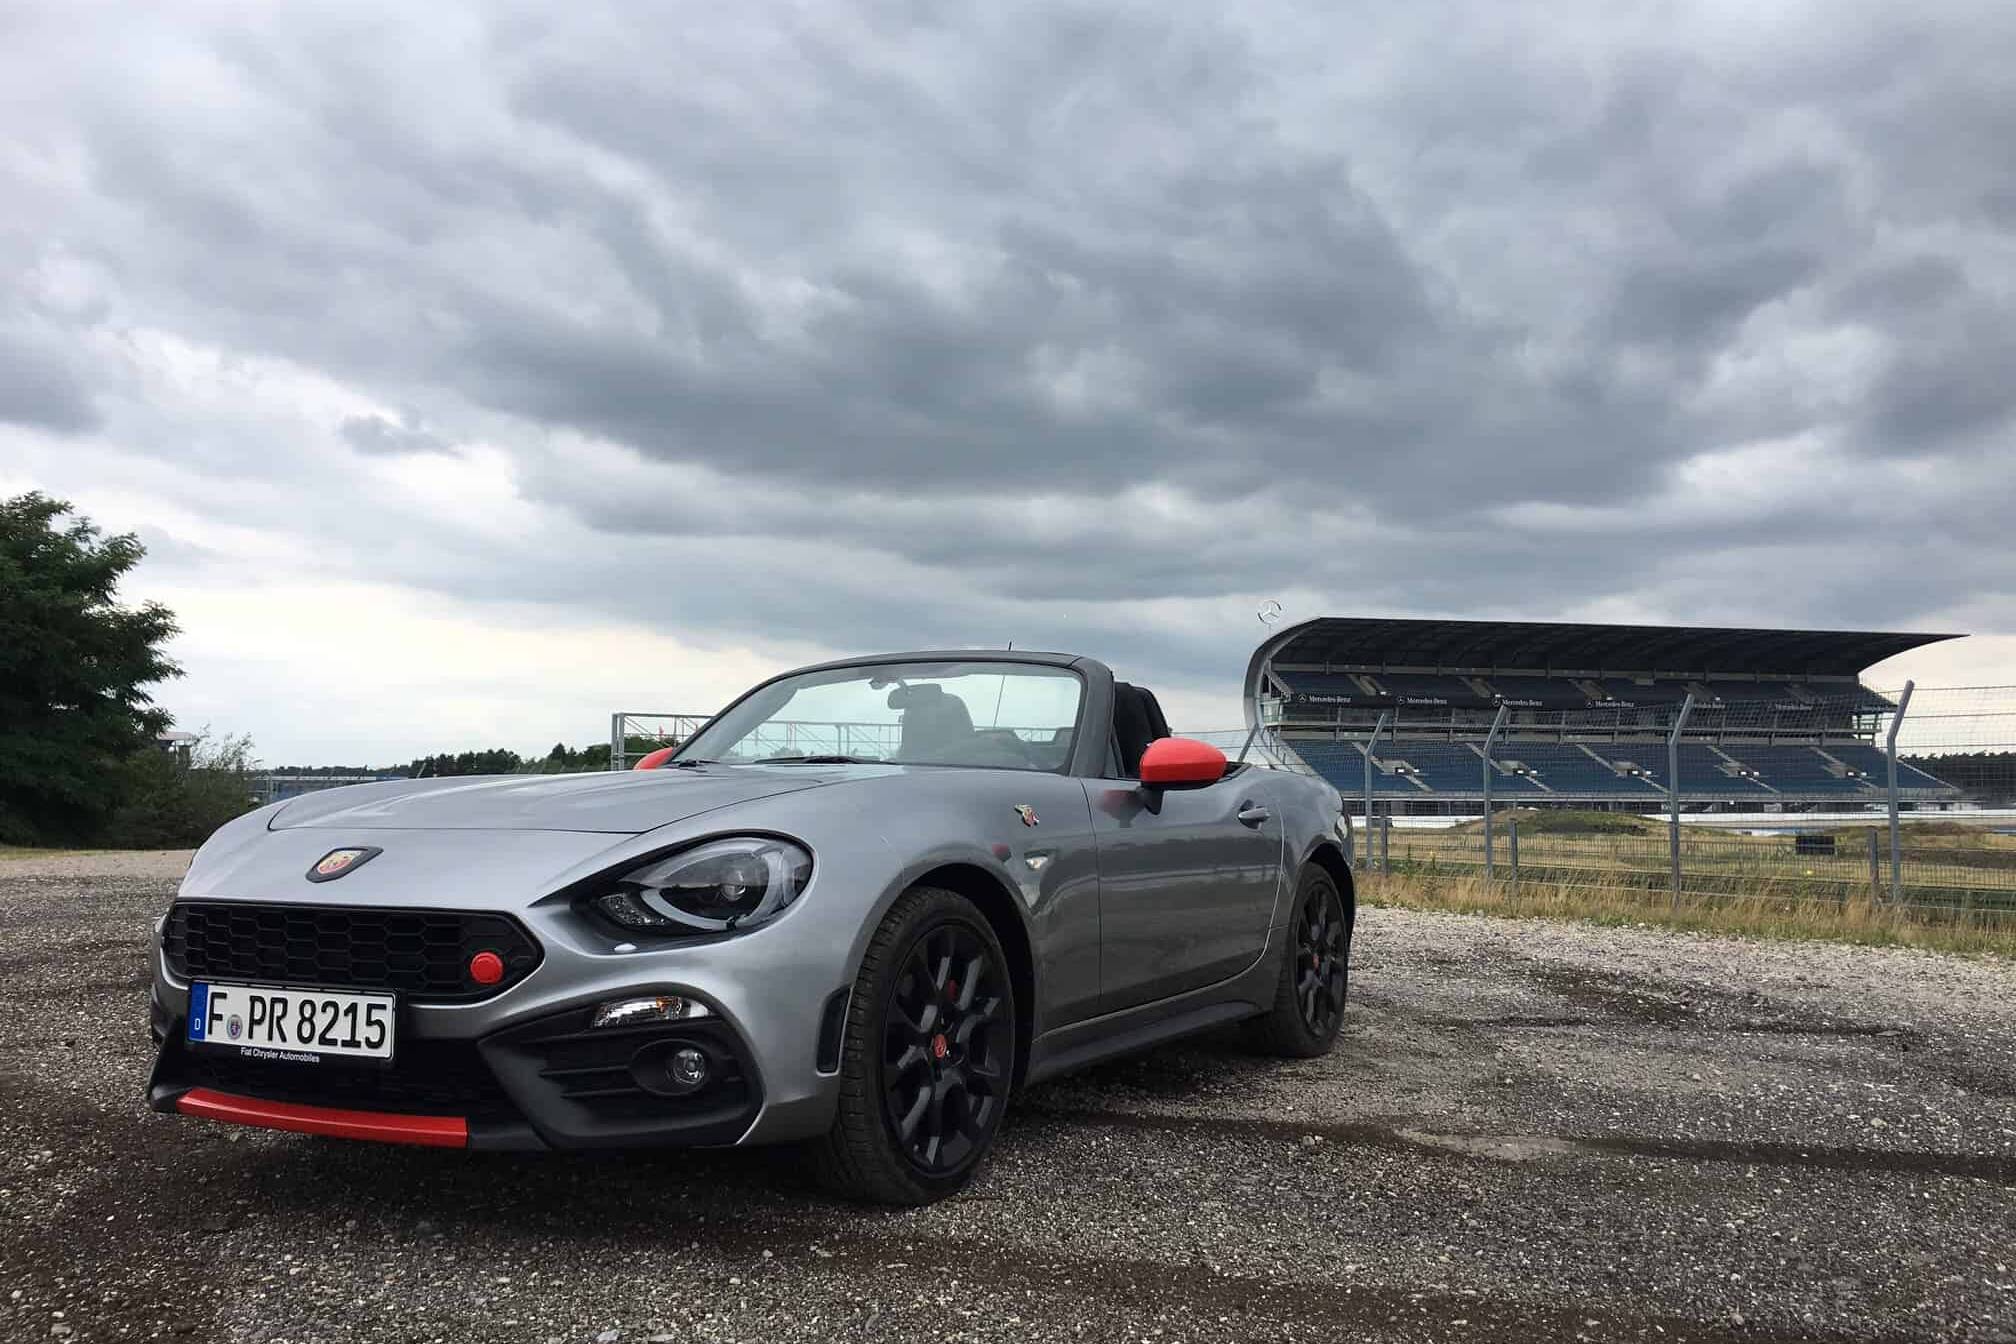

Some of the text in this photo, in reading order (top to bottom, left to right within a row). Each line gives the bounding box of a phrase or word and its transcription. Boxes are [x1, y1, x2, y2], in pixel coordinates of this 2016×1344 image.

[194, 1018, 202, 1030] D
[207, 992, 388, 1049] F PR 8215
[240, 1046, 320, 1063] Fiat Chrysler Automobiles
